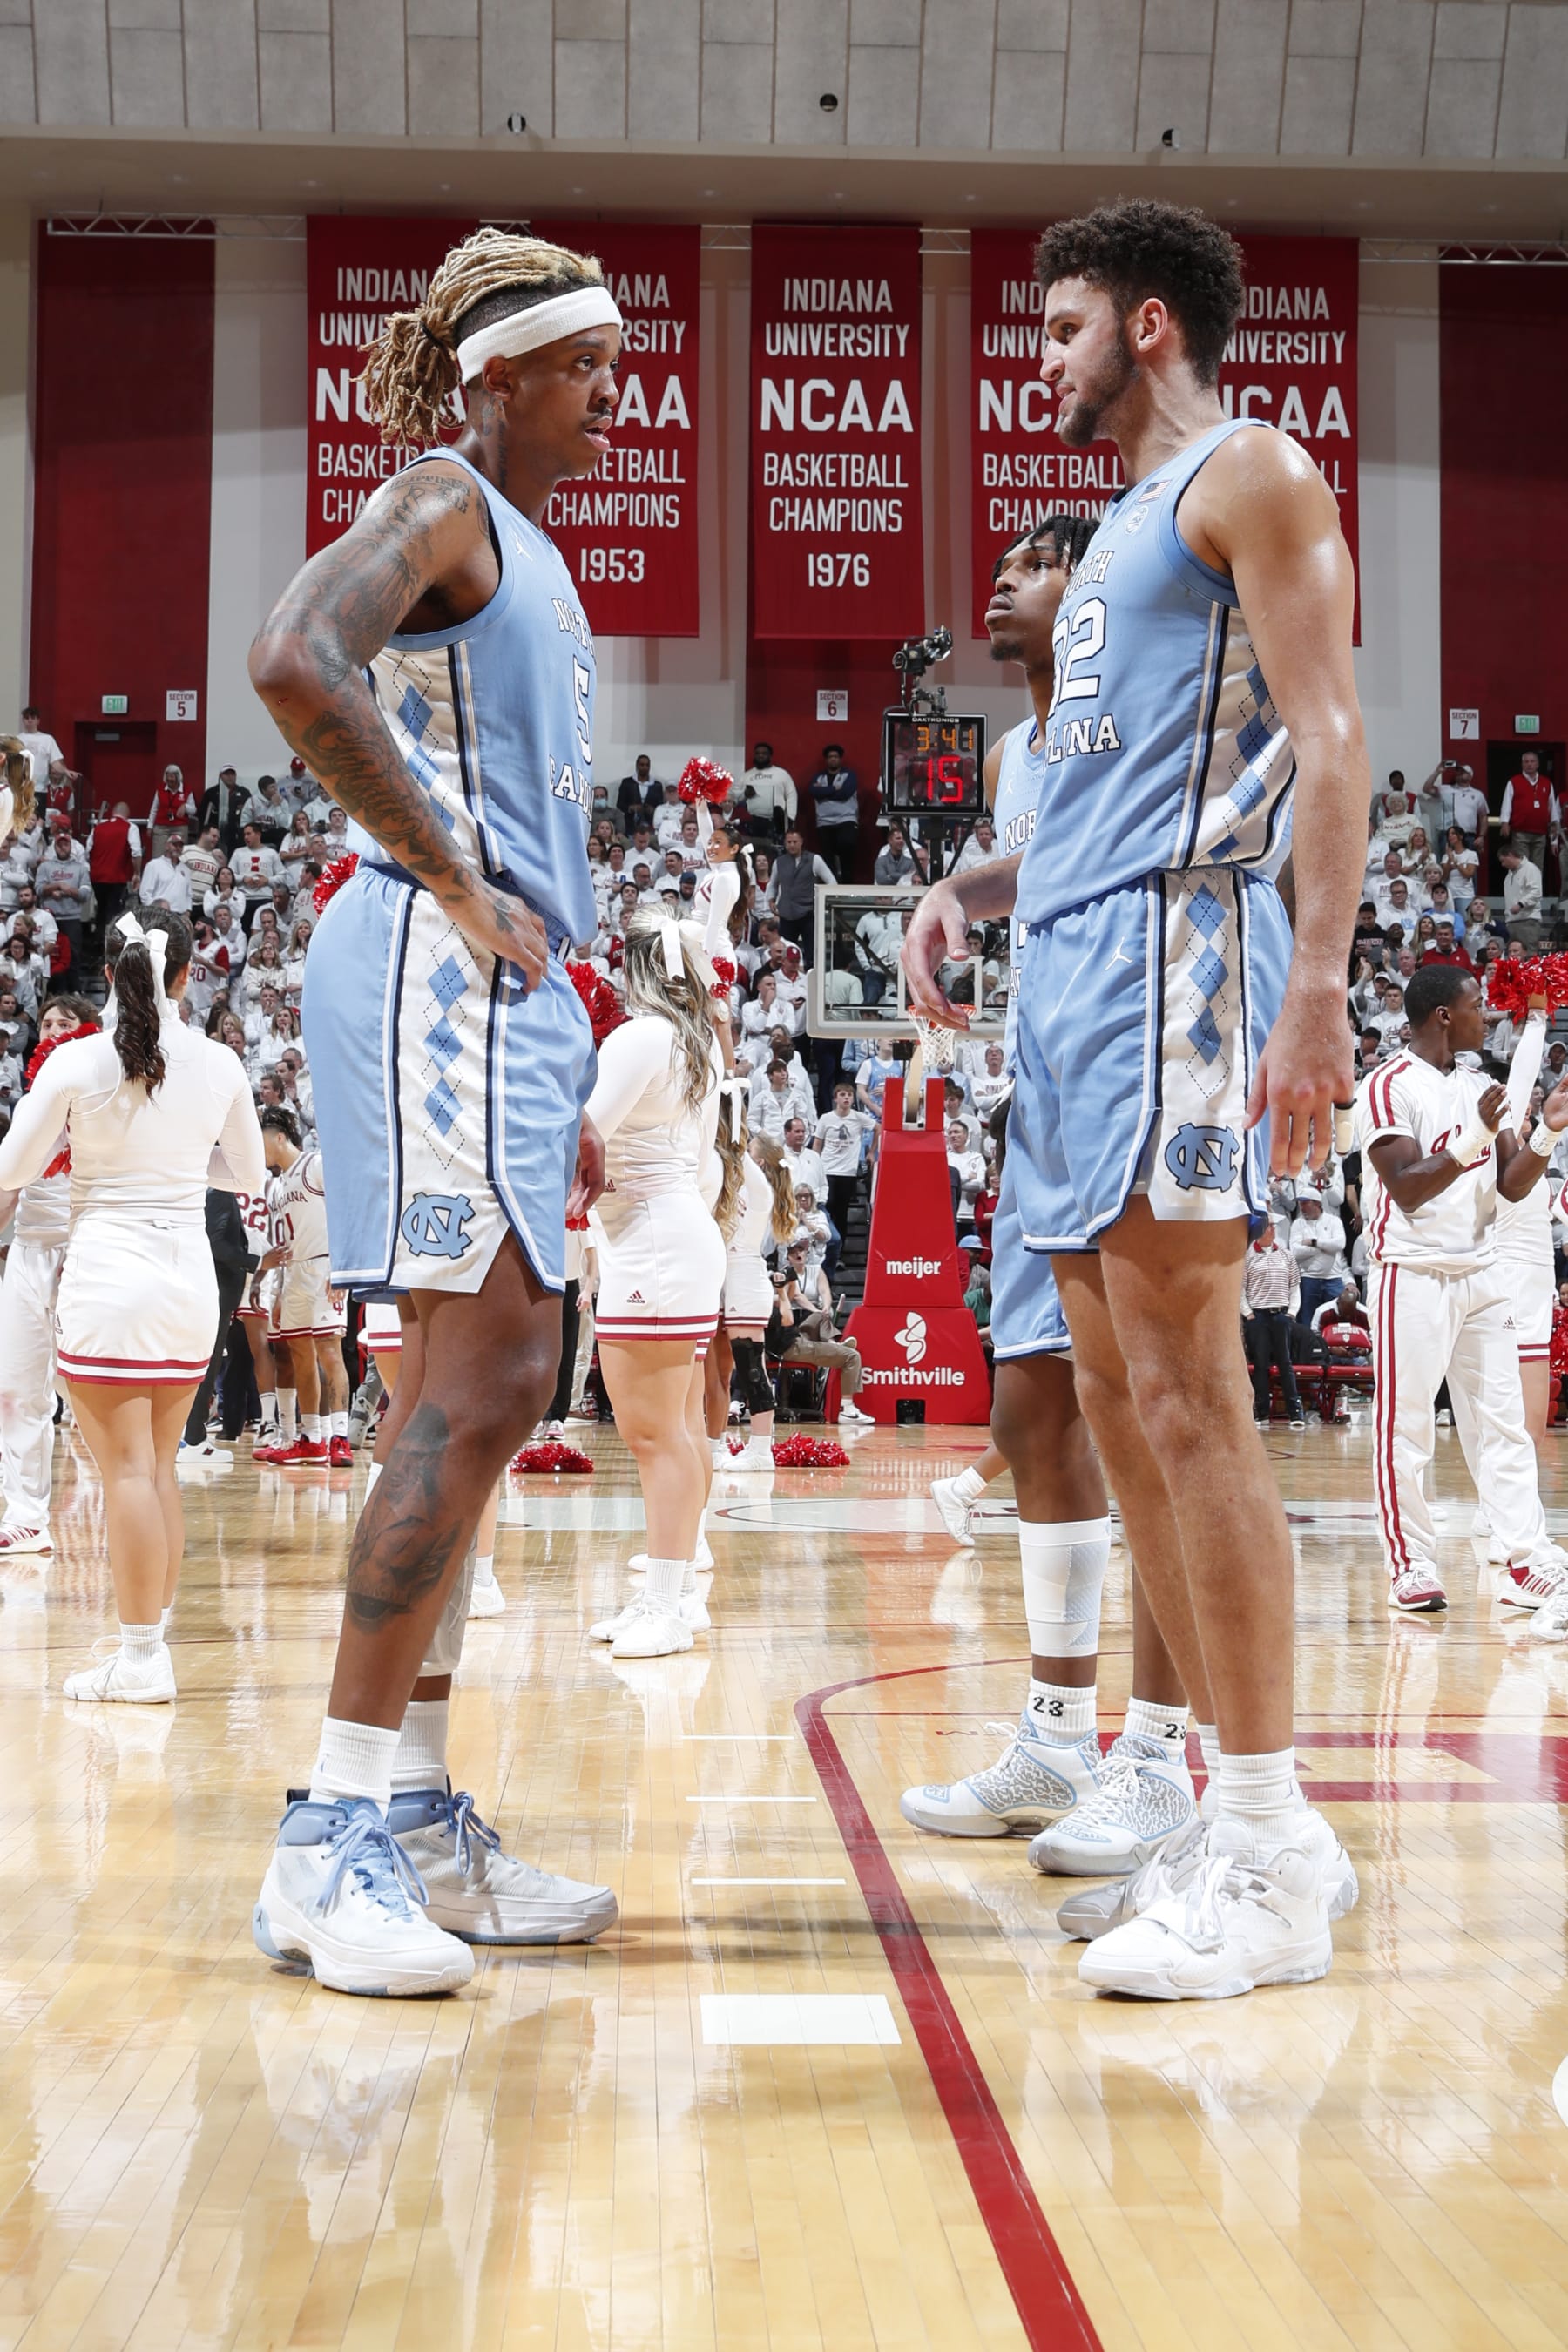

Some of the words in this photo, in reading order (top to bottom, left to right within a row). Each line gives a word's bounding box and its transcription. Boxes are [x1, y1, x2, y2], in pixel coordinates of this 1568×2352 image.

[337, 267, 427, 302] INDIAN
[606, 272, 671, 308] IANA
[783, 278, 894, 313] INDIANA
[1240, 287, 1331, 321] DIANA
[620, 319, 686, 354] RSITY
[765, 323, 910, 358] UNIVERSITY
[1221, 330, 1347, 365] NIVERSITY
[614, 374, 692, 429] AA
[760, 378, 915, 433] NCAA
[979, 379, 1061, 433] NC
[763, 451, 909, 489] BASKETBALL
[983, 452, 1126, 490] BASKETBALL
[547, 491, 680, 530] CHAMPIONS
[768, 497, 903, 533] CHAMPIONS
[988, 497, 1109, 532] CHAMPION
[579, 547, 645, 583] 1953
[807, 552, 871, 588] 1976
[105, 697, 125, 712] EXIT
[177, 700, 186, 717] 5
[572, 653, 591, 766] 5
[828, 700, 837, 717] 6
[917, 726, 974, 752] 3:41
[1046, 713, 1122, 767] LINA
[1460, 720, 1469, 735] 7
[1518, 717, 1537, 731] EXIT
[927, 754, 963, 803] 15
[1004, 808, 1037, 857] NOR
[885, 1256, 942, 1279] meijer
[861, 1366, 965, 1386] Smithville
[1032, 1696, 1064, 1718] 23
